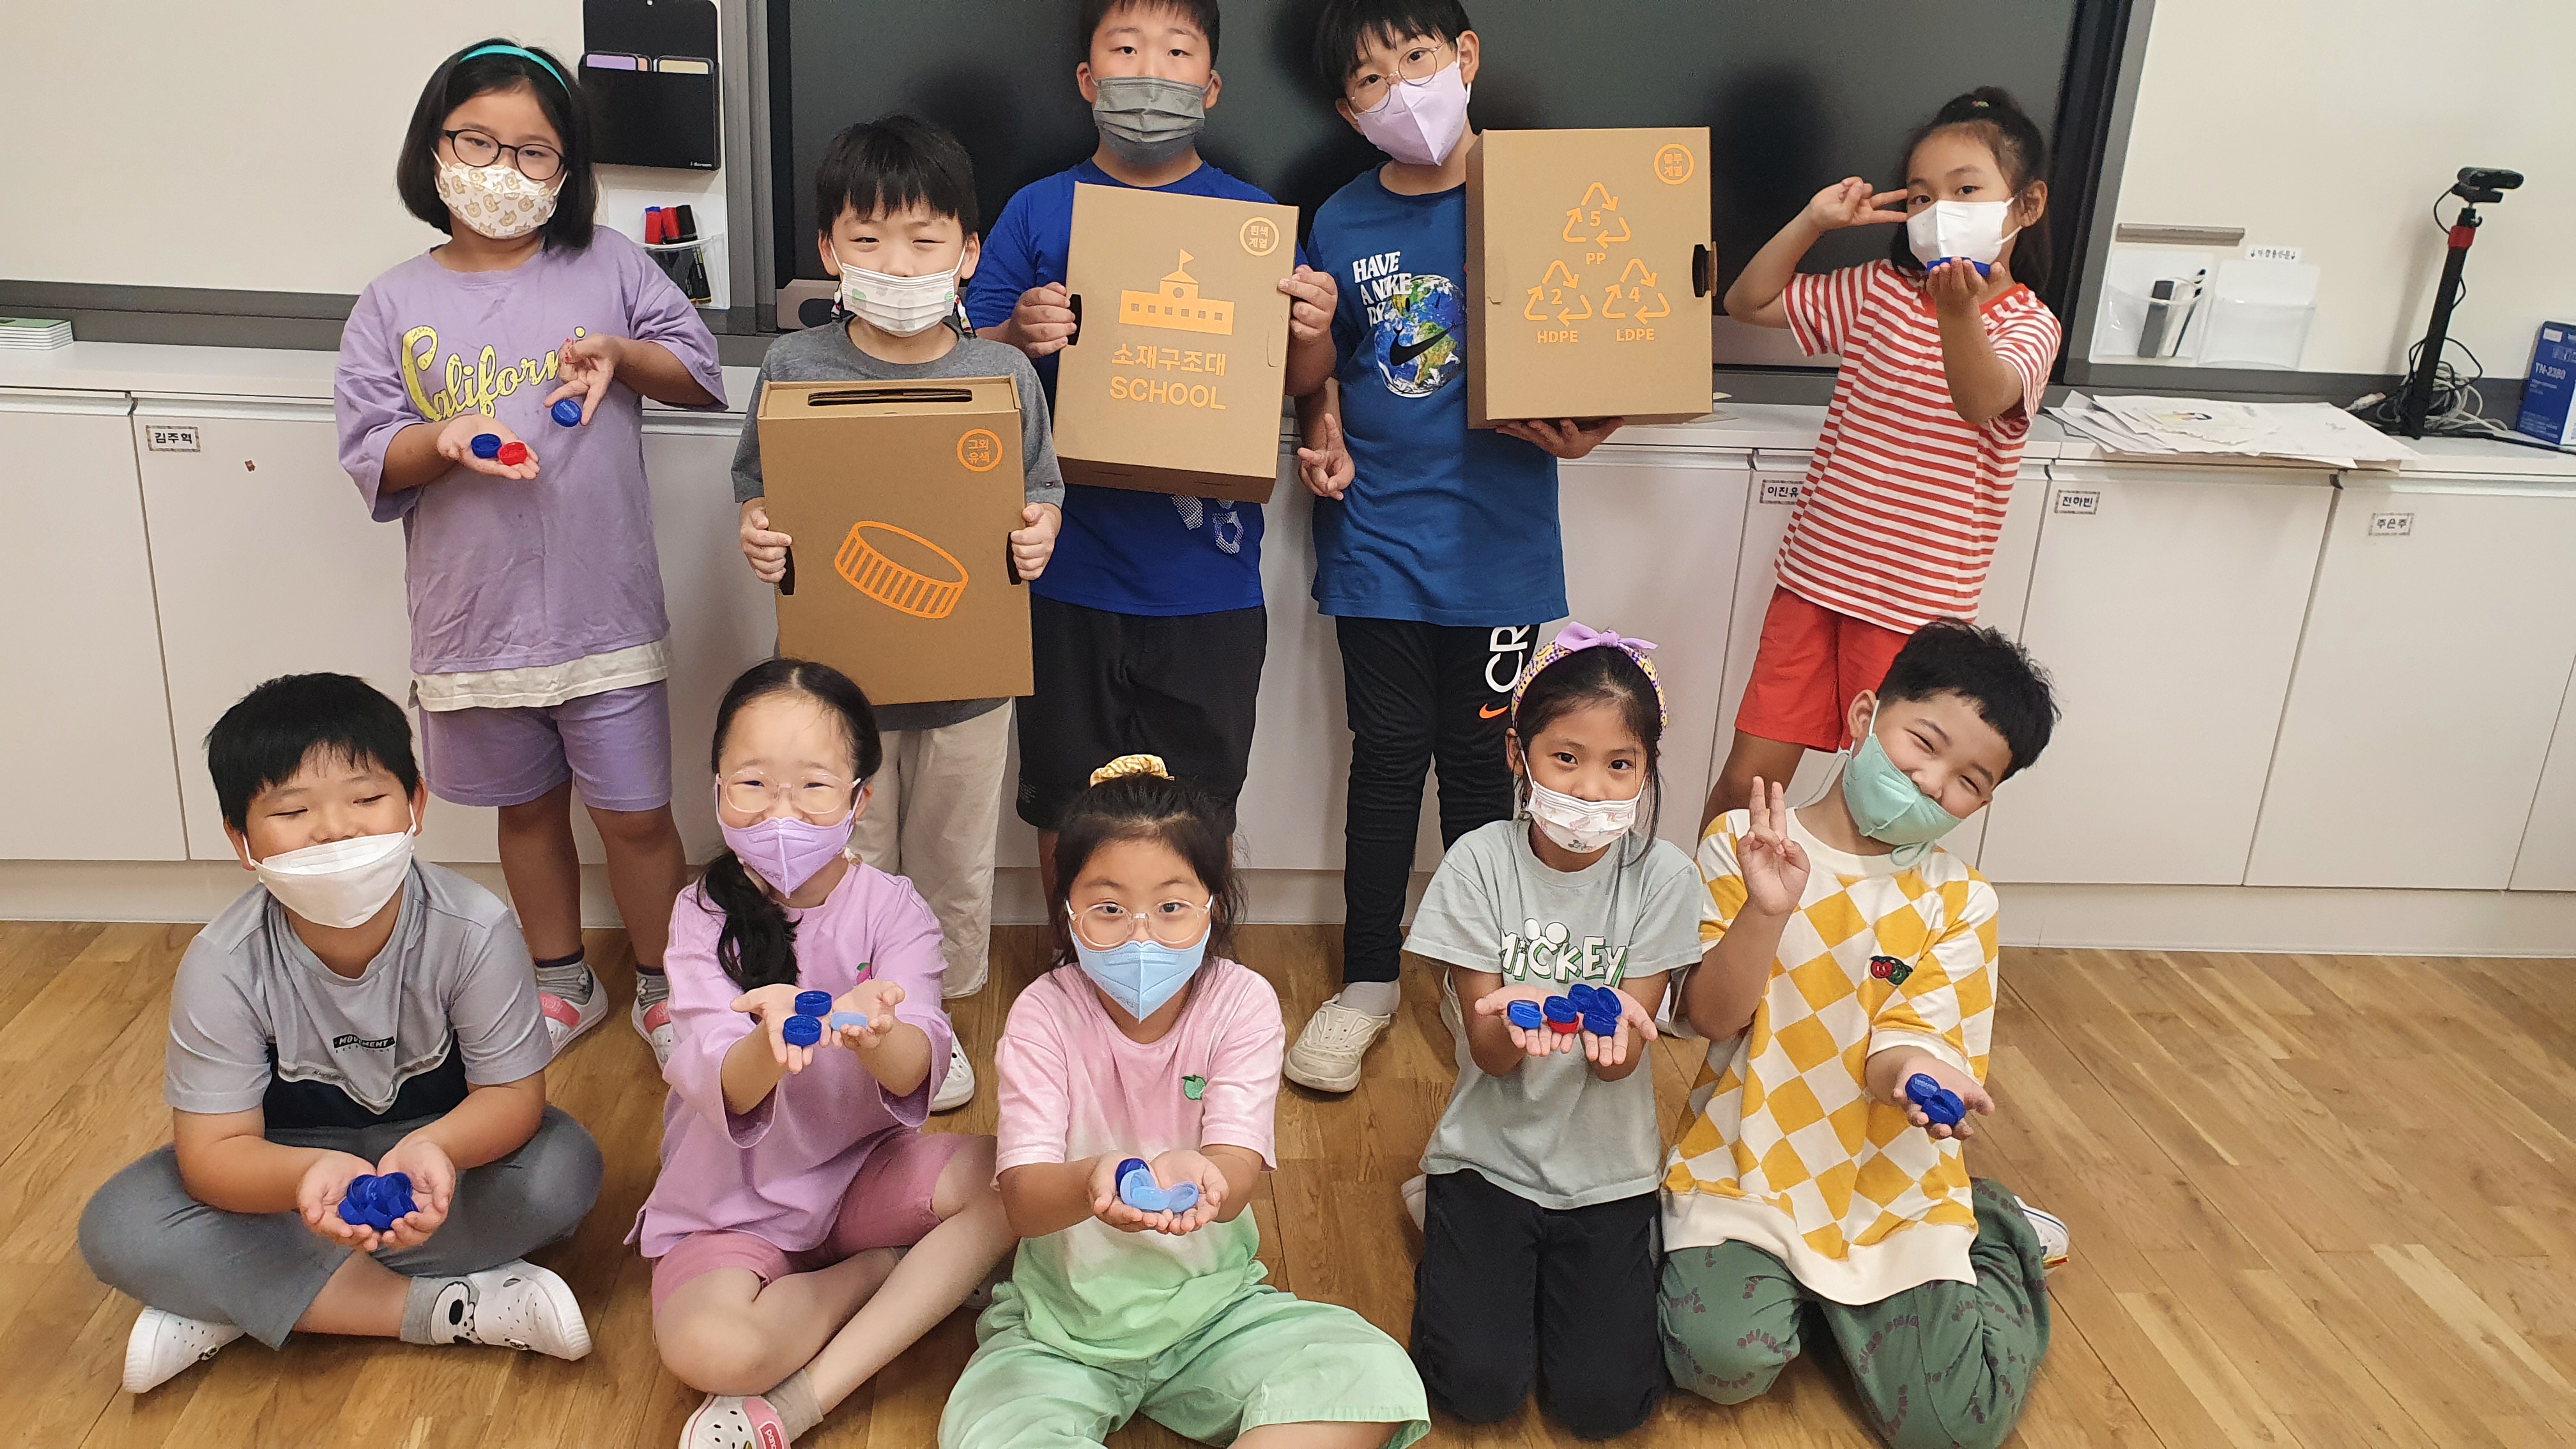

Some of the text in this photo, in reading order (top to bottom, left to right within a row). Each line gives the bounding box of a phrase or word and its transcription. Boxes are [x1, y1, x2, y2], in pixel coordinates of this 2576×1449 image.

[1590, 210, 1602, 227] 5
[1250, 225, 1269, 237] 흰색
[1248, 237, 1268, 249] 계열
[1586, 252, 1607, 265] PP
[1353, 251, 1401, 284] HAVE
[1360, 284, 1374, 306] A
[1551, 288, 1563, 305] 2
[1629, 286, 1641, 303] 4
[1537, 330, 1579, 344] HDPE
[1616, 328, 1655, 342] LDPE
[1111, 343, 1227, 376] 소재구조대
[1109, 376, 1227, 410] SCHOOL
[154, 432, 193, 445] 김주혁
[968, 438, 990, 450] 그외
[968, 451, 990, 464] 유색
[1767, 486, 1799, 498] 이진유
